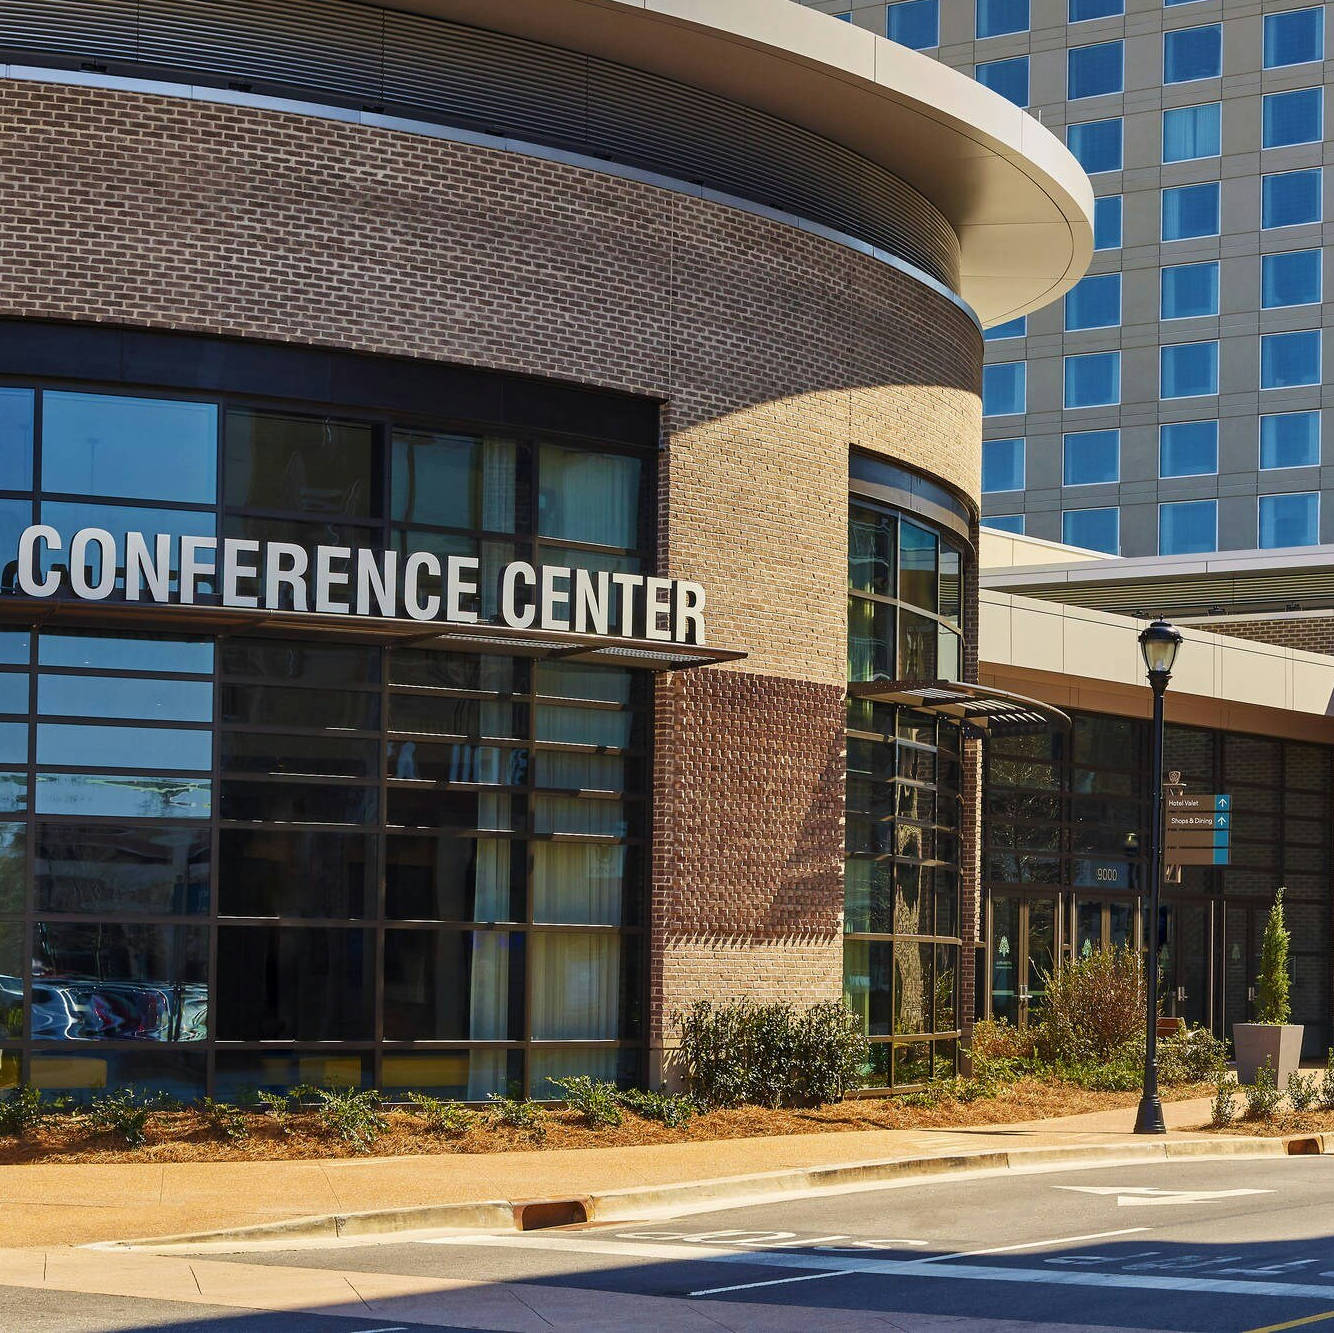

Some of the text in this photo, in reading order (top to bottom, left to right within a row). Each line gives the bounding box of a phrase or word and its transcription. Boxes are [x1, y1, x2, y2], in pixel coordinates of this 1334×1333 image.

[17, 524, 479, 624] CONFERENCE
[502, 561, 707, 645] CENTER
[1097, 868, 1117, 881] 9000
